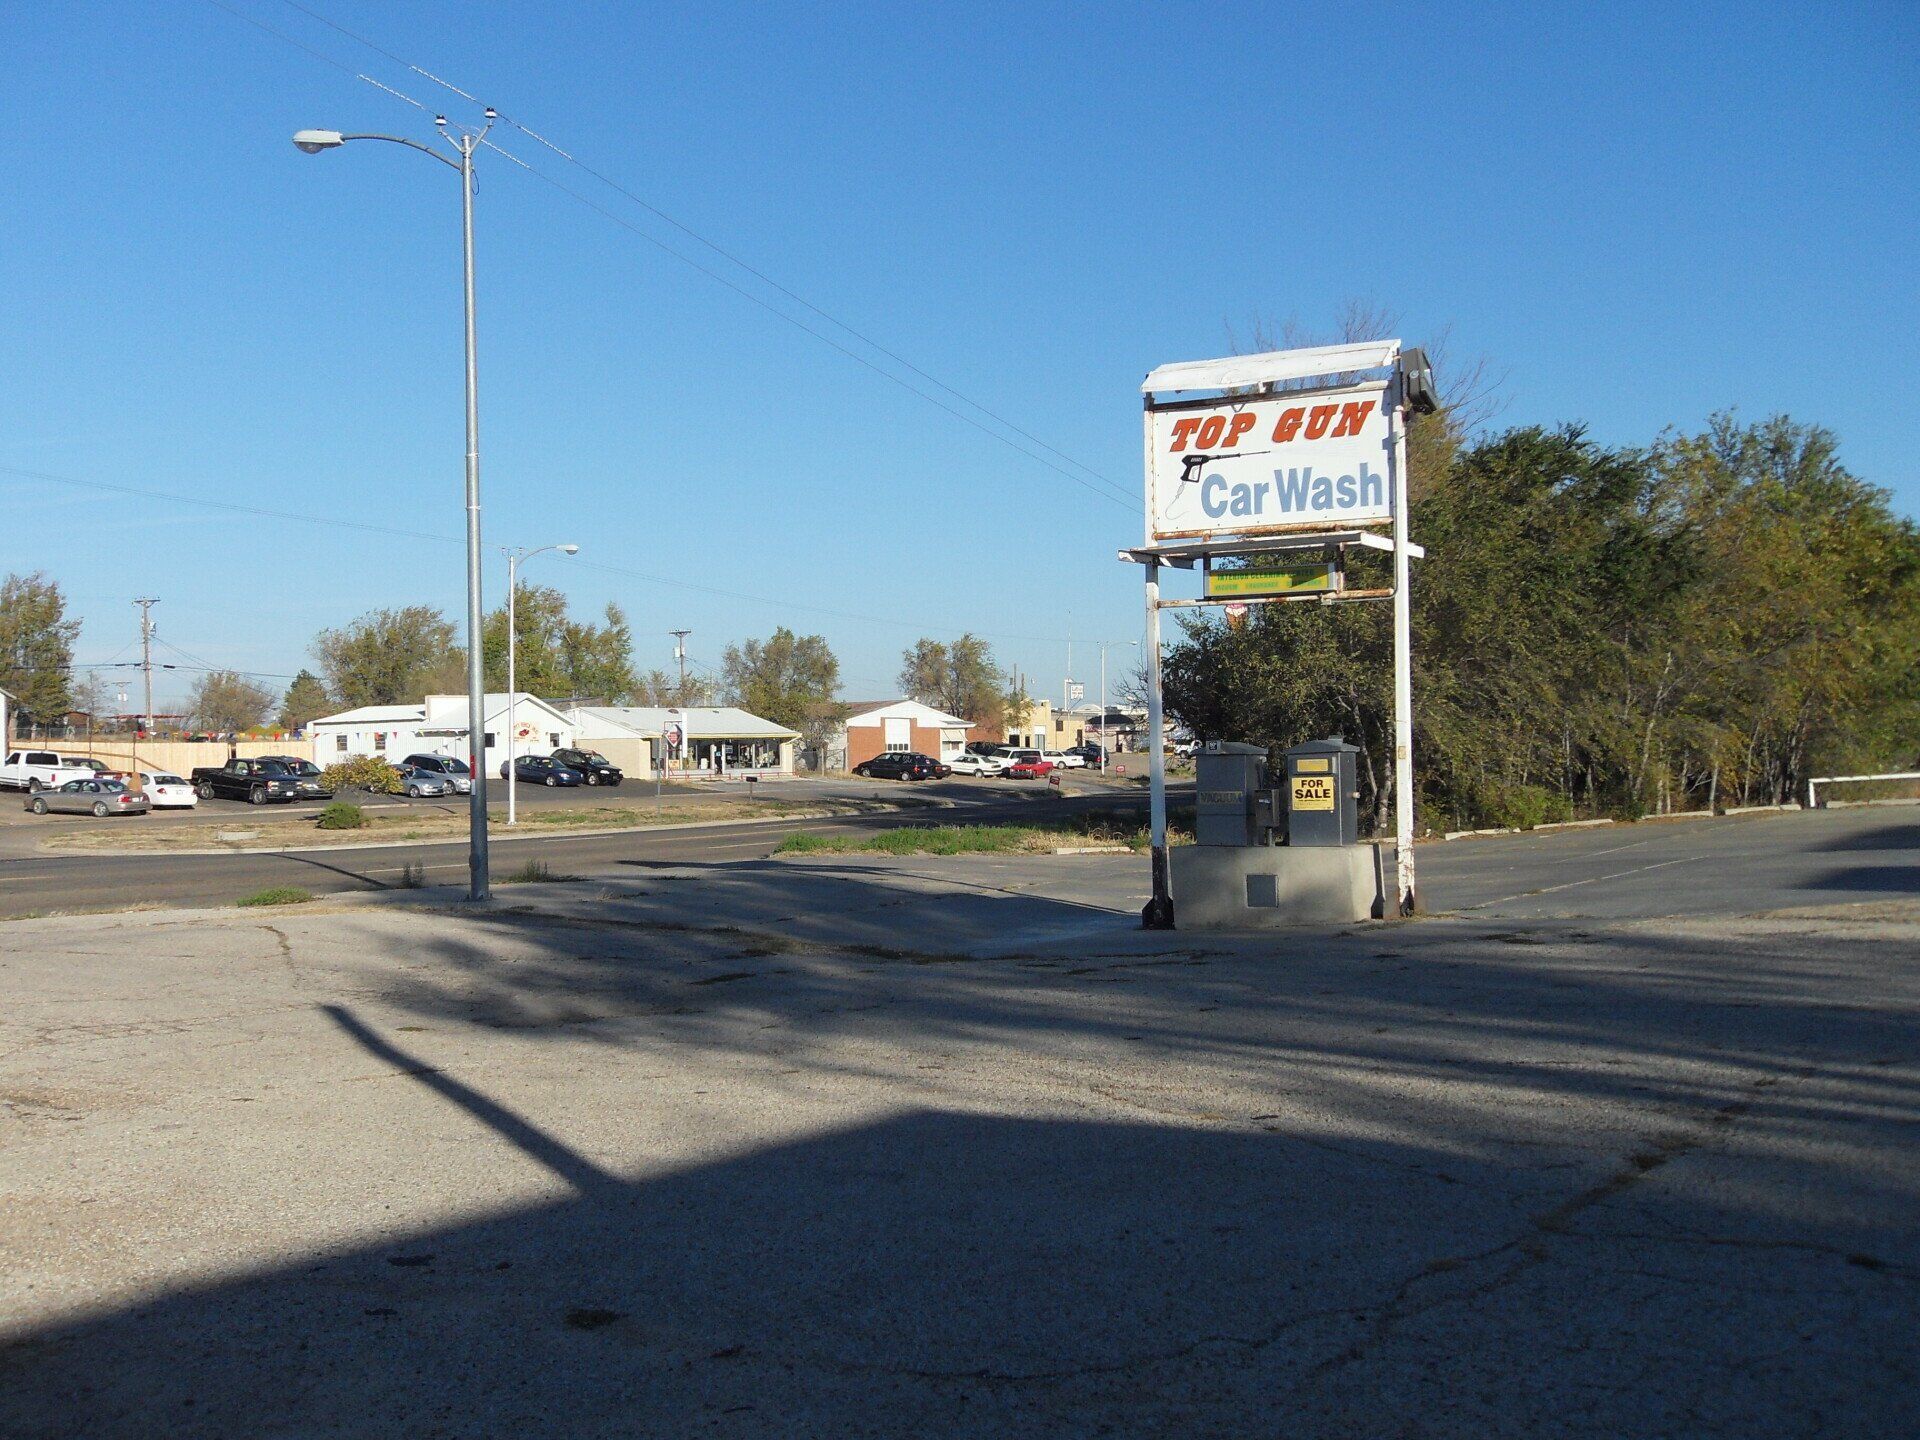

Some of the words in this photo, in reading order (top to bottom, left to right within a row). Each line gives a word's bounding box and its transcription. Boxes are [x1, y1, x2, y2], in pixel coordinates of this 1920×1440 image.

[1170, 412, 1257, 452] TOP
[1272, 400, 1376, 443] GUN
[1201, 473, 1269, 518] Car
[1274, 462, 1383, 513] Wash
[1295, 789, 1331, 799] SALE
[1301, 780, 1323, 788] FOR
